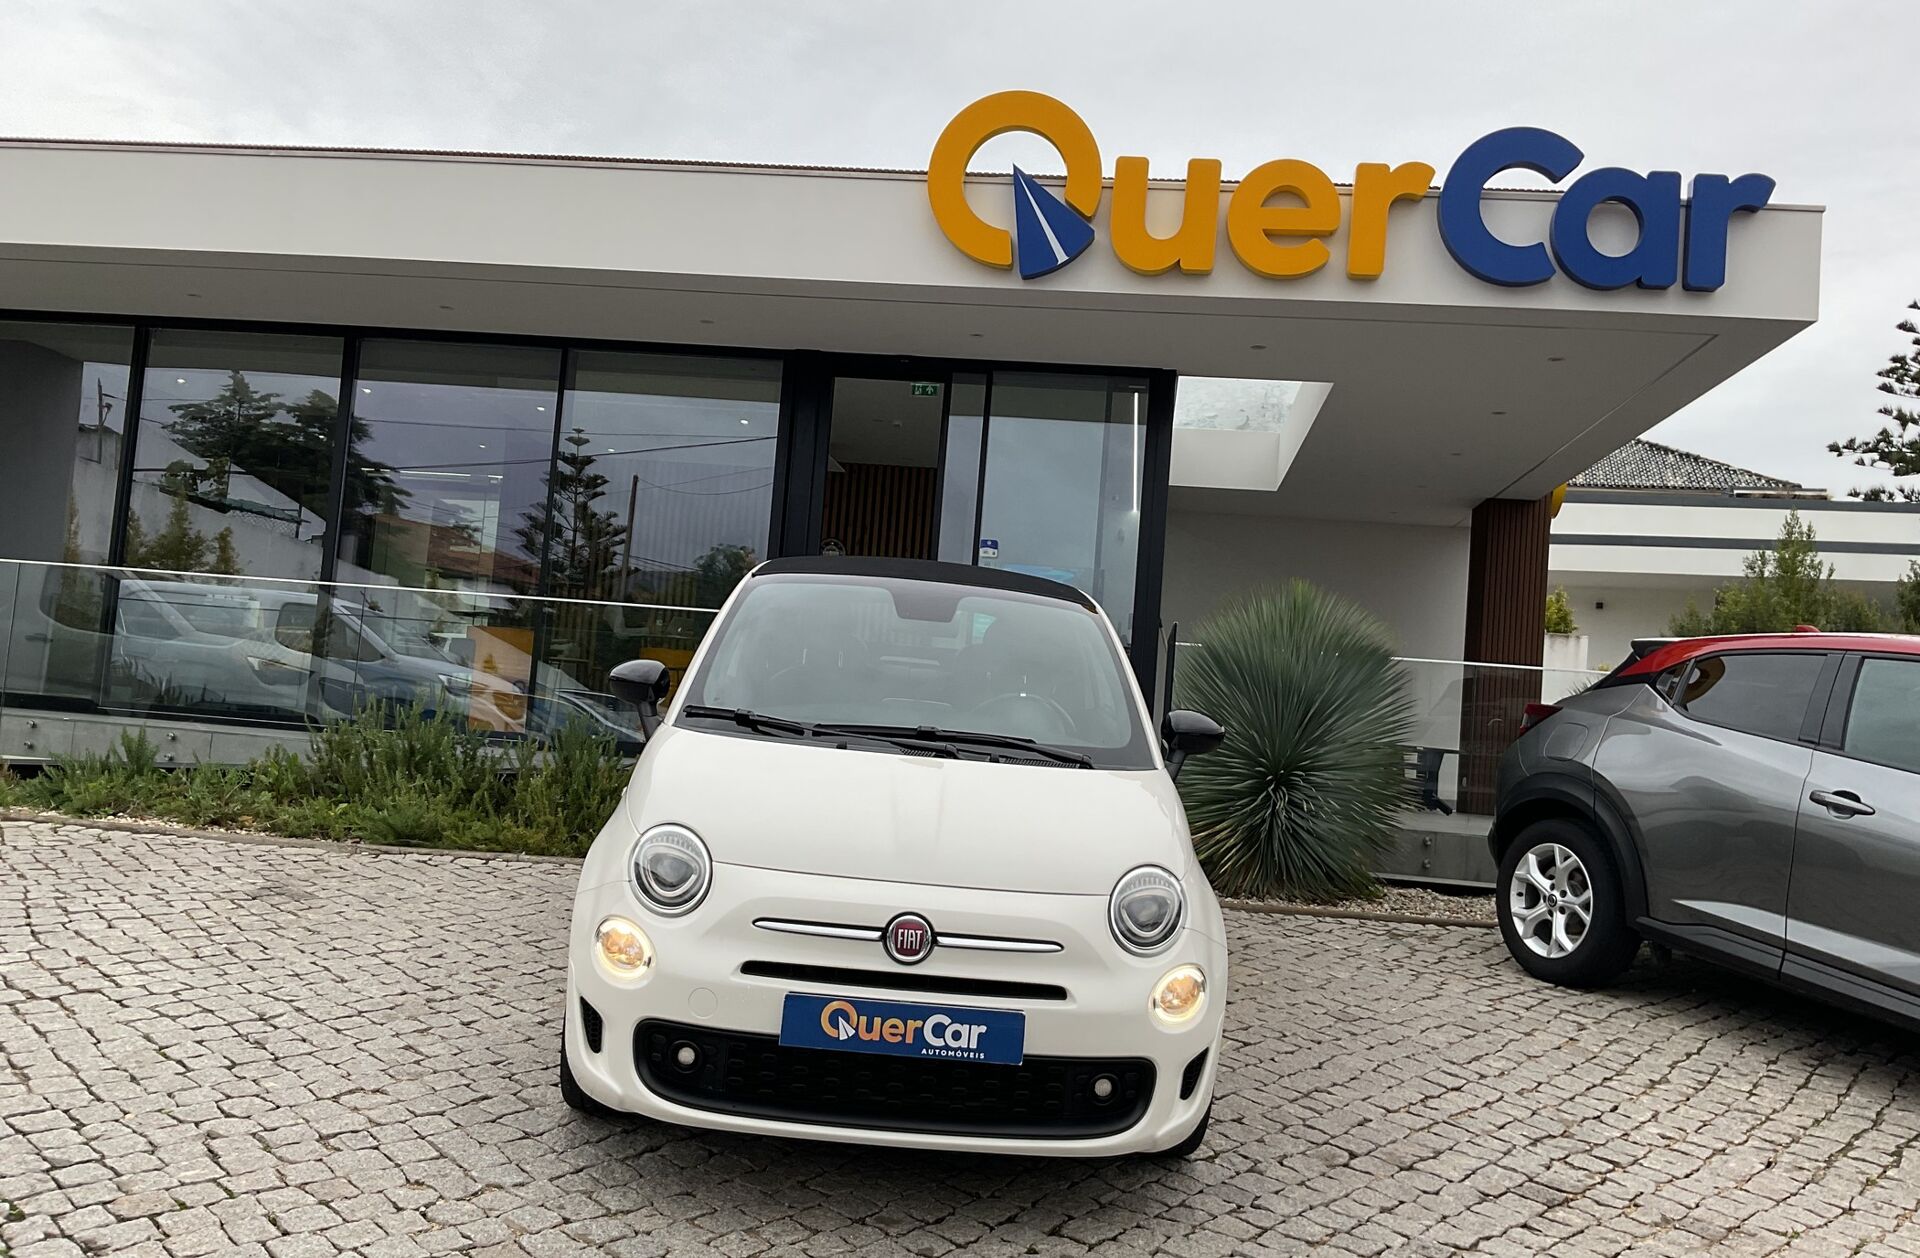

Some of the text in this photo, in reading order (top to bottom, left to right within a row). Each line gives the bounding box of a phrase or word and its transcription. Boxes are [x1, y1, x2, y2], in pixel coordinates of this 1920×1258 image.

[927, 90, 1774, 292] QuerCar
[897, 928, 923, 950] FIAT
[820, 1001, 987, 1049] QuerCar
[921, 1048, 985, 1059] AUTOMÓVEIS
